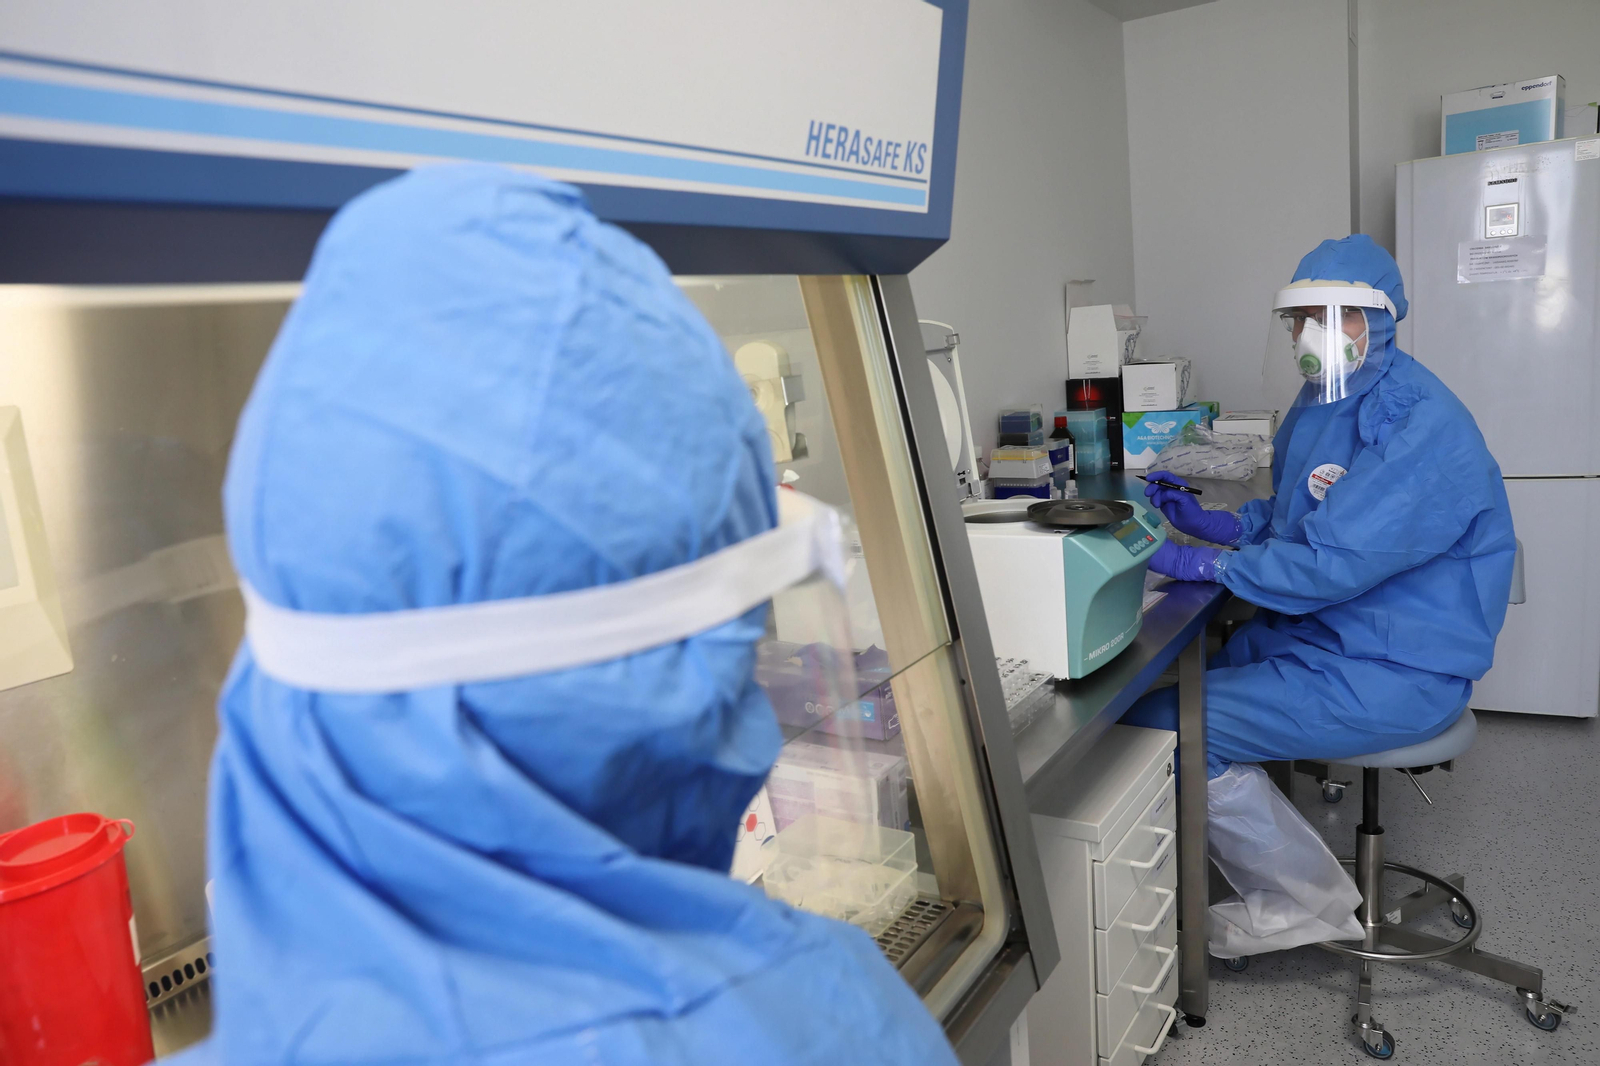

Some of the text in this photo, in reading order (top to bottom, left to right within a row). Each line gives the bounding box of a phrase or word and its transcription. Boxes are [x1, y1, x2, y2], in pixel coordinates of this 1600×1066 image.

[1521, 81, 1552, 91] eppendorf
[903, 140, 927, 174] KS
[1088, 642, 1110, 661] MIKRO
